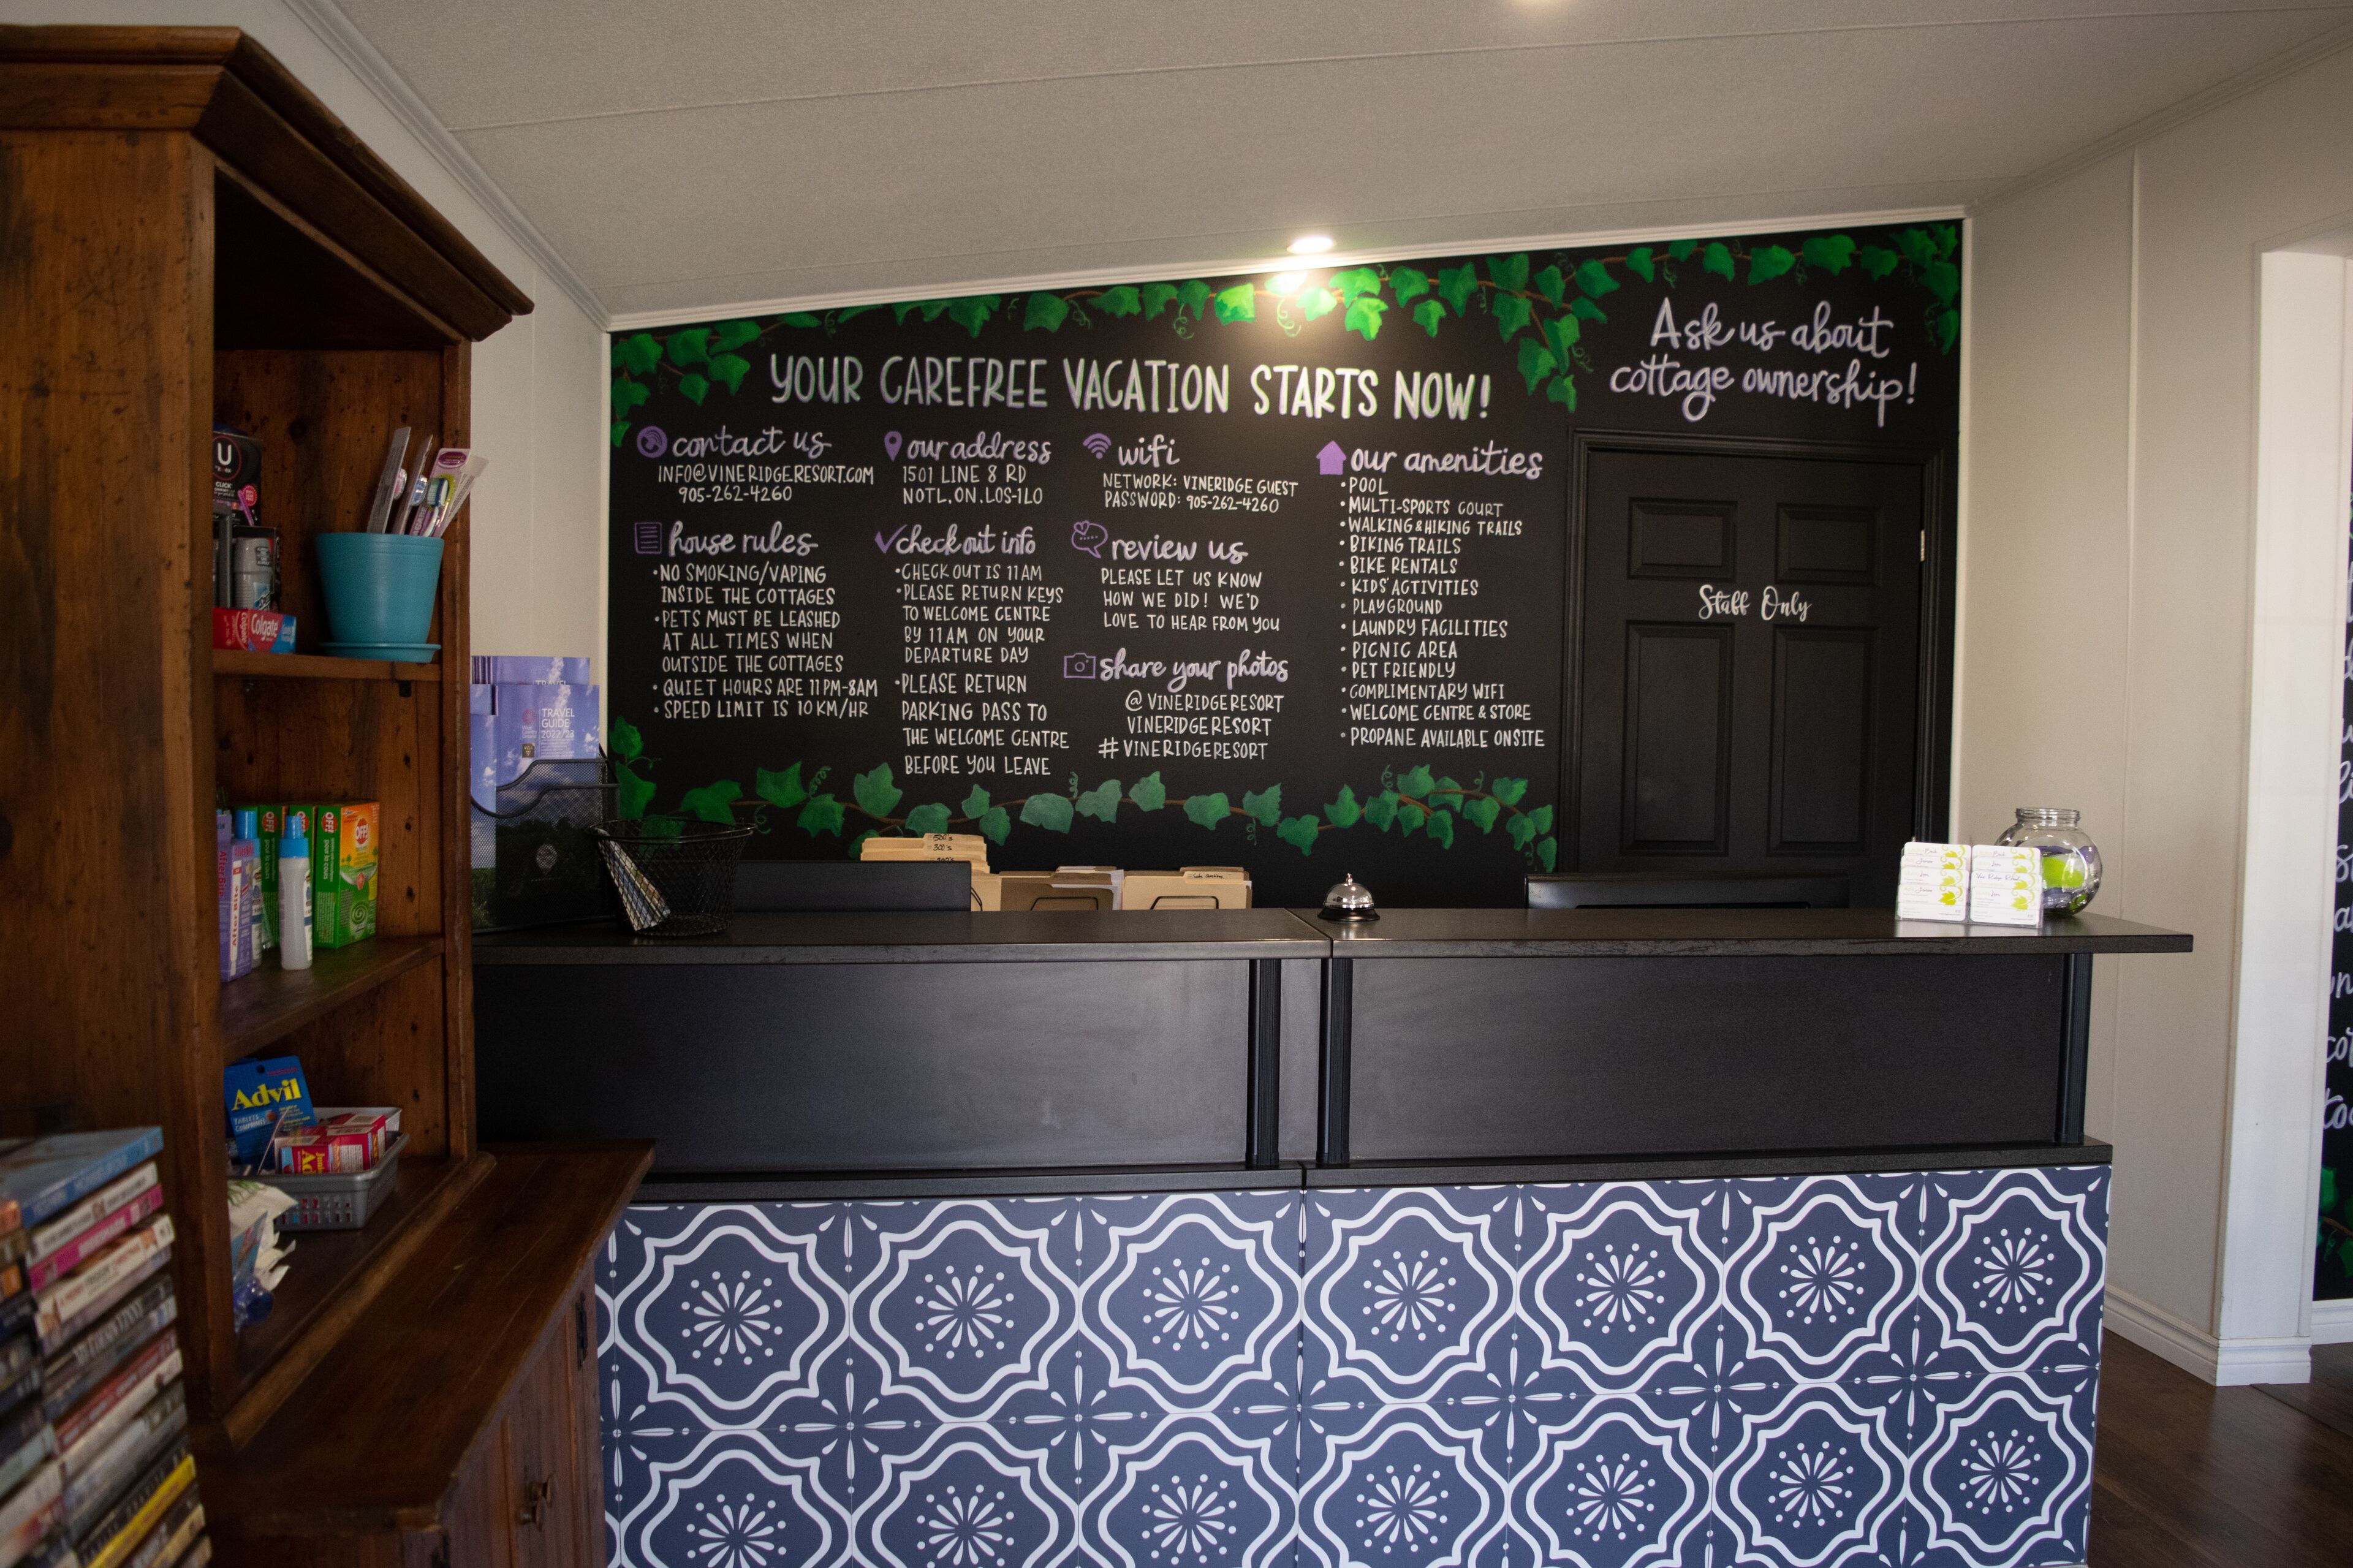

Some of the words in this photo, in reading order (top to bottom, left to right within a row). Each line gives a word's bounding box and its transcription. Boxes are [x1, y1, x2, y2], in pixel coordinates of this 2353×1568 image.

[1650, 297, 1736, 350] Ask
[1739, 320, 1786, 352] us
[1790, 300, 1895, 359] about
[770, 353, 863, 404] YOUR
[880, 355, 1048, 409] CAREFREE
[1063, 357, 1229, 414] VACATION
[1250, 364, 1379, 420] STARTS
[1393, 369, 1491, 422] NOW!
[1609, 353, 1735, 423] cottage
[1741, 358, 1917, 428] ownership!
[672, 425, 786, 458] contact
[793, 431, 833, 460] us
[907, 439, 949, 461] our
[950, 431, 1052, 465] address
[1118, 433, 1180, 468] wifi
[1350, 448, 1398, 473] our
[1403, 439, 1543, 480] amenities
[903, 465, 933, 484] 1501
[941, 464, 980, 484] LINE
[988, 464, 998, 483] 8
[1006, 463, 1026, 484] RD
[678, 484, 792, 504] 905-262-4260
[1103, 472, 1177, 490] NETWORK:
[1183, 474, 1254, 494] VINERIDGE
[1256, 479, 1299, 498] GUEST
[1349, 476, 1389, 496] POOL
[1105, 490, 1181, 509] PASSWORD:
[1186, 494, 1279, 513] 905-262-4260
[1348, 495, 1450, 515] MULTI-SPORTS
[1457, 501, 1504, 518] COURT
[669, 520, 737, 557] house
[742, 520, 819, 556] rules
[1477, 520, 1523, 537] TRAILS
[1001, 525, 1036, 555] info
[1112, 534, 1197, 562] review
[1208, 540, 1249, 565] us
[1349, 534, 1404, 553] BIKING
[1408, 536, 1461, 555] TRAILS
[659, 564, 680, 581] NO
[686, 561, 827, 586] SMOKING/VAPING
[901, 562, 950, 581] CHECK
[952, 564, 981, 580] OUT
[985, 563, 1001, 580] IS
[1350, 555, 1386, 575] BIKE
[1391, 556, 1458, 575] RENTALS
[1101, 567, 1152, 586] PLEASE
[1157, 569, 1184, 586] LET
[1192, 571, 1211, 587] US
[1218, 571, 1262, 589] KNOW
[1391, 578, 1479, 596] ACTIVITIES
[661, 584, 714, 604] INSIDE
[721, 587, 752, 605] THE
[756, 587, 836, 606] COTTAGES
[903, 583, 955, 601] PLEASE
[961, 583, 1022, 602] RETURN
[1027, 585, 1064, 604] KEYS
[1103, 589, 1134, 607] HOW
[1142, 591, 1167, 608] WE
[1698, 583, 1751, 620] Staff
[1760, 585, 1813, 623] Only
[902, 605, 919, 621] TO
[922, 605, 990, 622] WELCOME
[995, 605, 1051, 622] CENTRE
[1353, 597, 1443, 615] PLAYGROUND
[251, 613, 279, 642] Colgate
[662, 609, 701, 628] PETS
[706, 609, 748, 628] MUST
[753, 610, 773, 627] BE
[780, 609, 841, 629] LEASHED
[1104, 612, 1140, 629] LOVE
[1146, 614, 1165, 629] TO
[1171, 614, 1208, 631] HEAR
[1212, 615, 1248, 632] FROM
[1252, 616, 1280, 634] YOU
[1352, 618, 1416, 637] LAUNDRY
[1422, 618, 1508, 638] FACILITIES
[662, 632, 684, 651] AT
[691, 632, 719, 651] ALL
[725, 631, 779, 650] TIMES
[786, 631, 833, 650] WHEN
[904, 625, 922, 644] BY
[977, 626, 998, 643] ON
[1007, 626, 1045, 643] YOUR
[905, 646, 993, 664] DEPARTURE
[1001, 646, 1029, 664] DAY
[1352, 641, 1411, 659] PICNIC
[1417, 640, 1458, 659] AREA
[662, 654, 729, 674] OUTSIDE
[735, 654, 763, 673] THE
[768, 654, 844, 673] COTTAGES
[1099, 647, 1167, 681] share
[1167, 660, 1222, 694] your
[1226, 648, 1289, 691] photos
[1352, 661, 1378, 679] PET
[1384, 661, 1456, 679] FRIENDLY
[663, 678, 717, 697] QUIET
[722, 678, 773, 696] HOURS
[776, 677, 804, 697] ARE
[901, 672, 958, 695] PLEASE
[964, 673, 1027, 695] RETURN
[1349, 682, 1468, 701] COMPLIMENTARY
[1472, 683, 1505, 700] WIFI
[542, 708, 575, 718] TRAVEL
[664, 700, 711, 719] SPEED
[717, 700, 765, 718] LIMIT
[772, 699, 789, 717] IS
[901, 700, 973, 722] PARKING
[982, 701, 1021, 722] PASS
[1026, 703, 1047, 722] TO
[1349, 703, 1420, 722] WELCOME
[1423, 704, 1475, 721] CENTRE
[1478, 705, 1487, 719] &
[1489, 703, 1531, 721] STORE
[542, 719, 570, 728] GUIDE
[902, 727, 929, 747] THE
[934, 727, 1005, 748] WELCOME
[1010, 729, 1070, 749] CENTRE
[1351, 727, 1417, 747] PROPANE
[1420, 728, 1489, 749] AVAILABLE
[1493, 728, 1545, 748] ONSITE
[904, 754, 960, 775] BEFORE
[966, 754, 996, 775] YOU
[1004, 756, 1051, 776] LEAVE
[266, 811, 275, 833] OFF!
[325, 812, 334, 833] OFF!
[356, 823, 369, 840] OFF!
[232, 1078, 302, 1111] Advil
